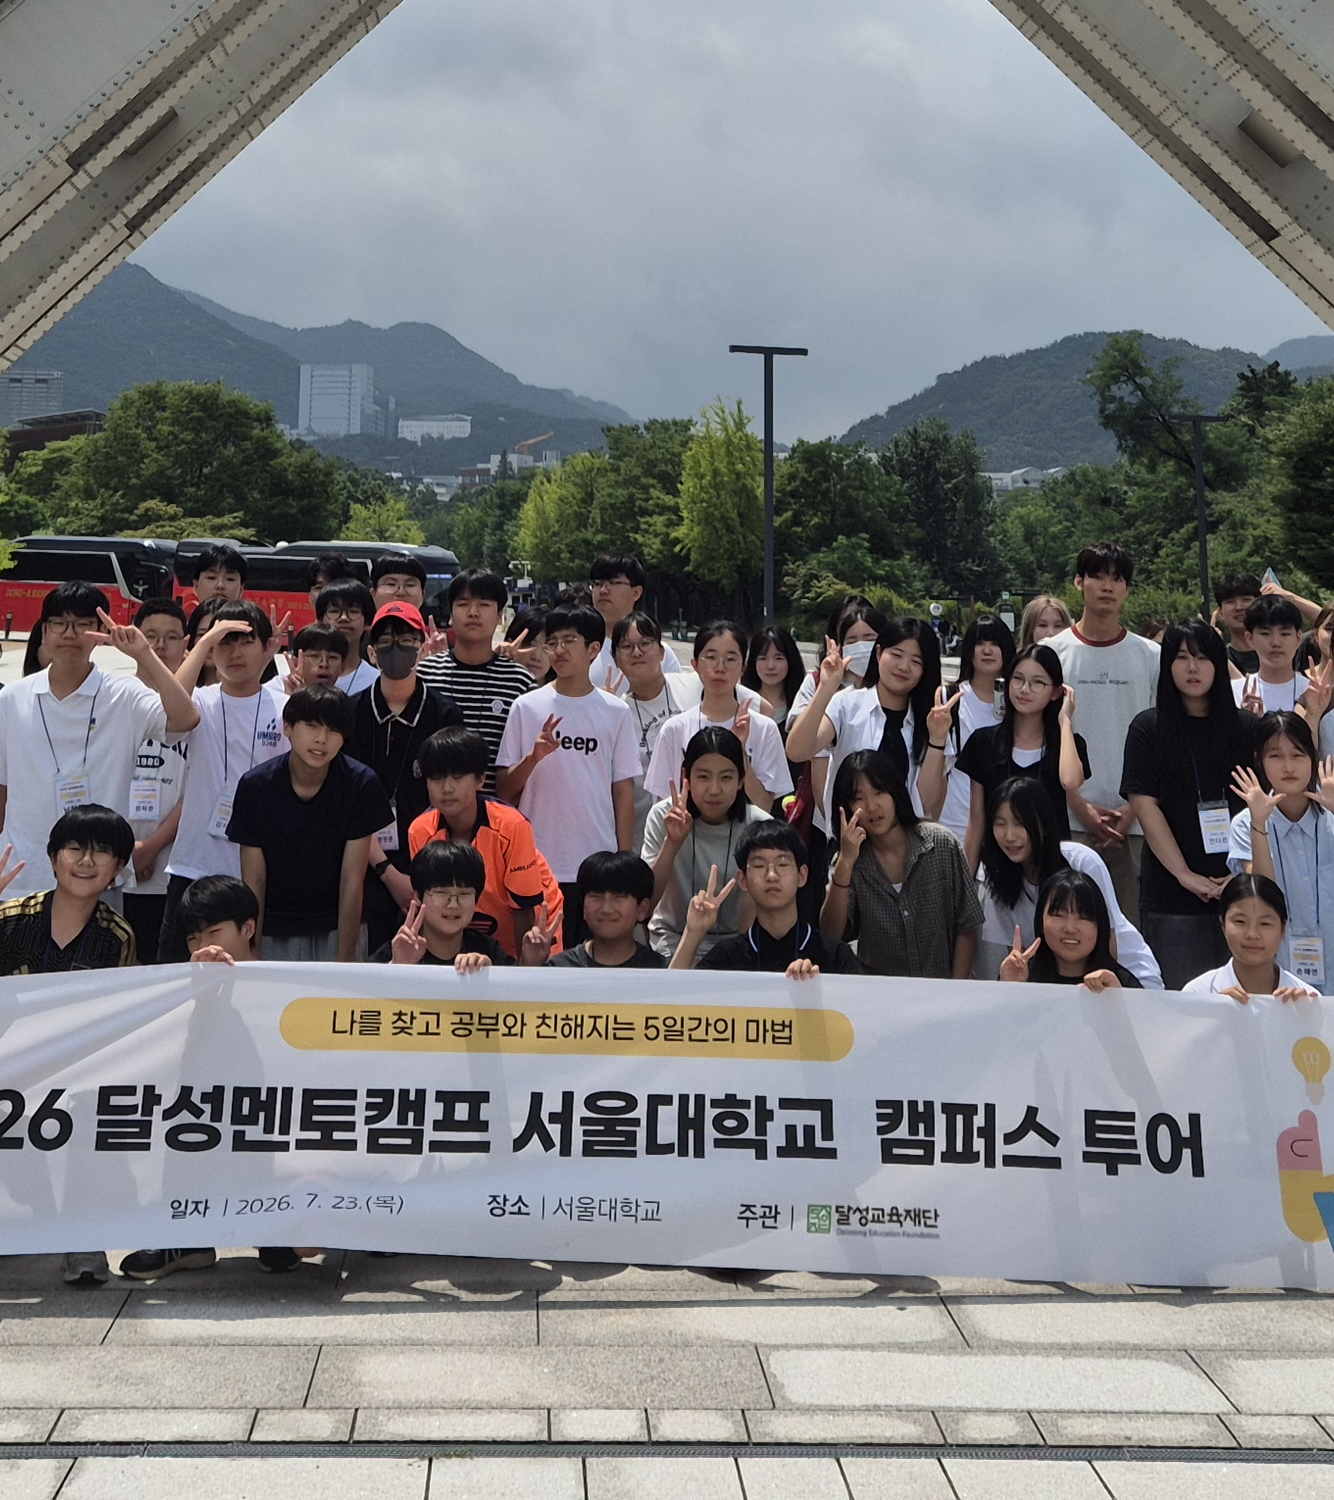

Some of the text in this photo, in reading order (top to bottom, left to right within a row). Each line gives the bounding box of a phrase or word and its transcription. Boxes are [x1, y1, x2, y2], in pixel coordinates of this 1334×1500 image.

[330, 1009, 794, 1045] 나를 찾고 공부와 친해지는 5일간의 마법
[93, 1085, 492, 1156] 달성멘토캠프
[512, 1090, 838, 1161] 서울대학교
[875, 1099, 1063, 1170] 캠퍼스
[1082, 1108, 1205, 1178] 투어
[170, 1193, 404, 1220] 일자 2026. 7. 23.(목)
[487, 1194, 663, 1224] 장소 서울대학교
[737, 1203, 781, 1229] 주관
[835, 1204, 940, 1228] 달성교육재단
